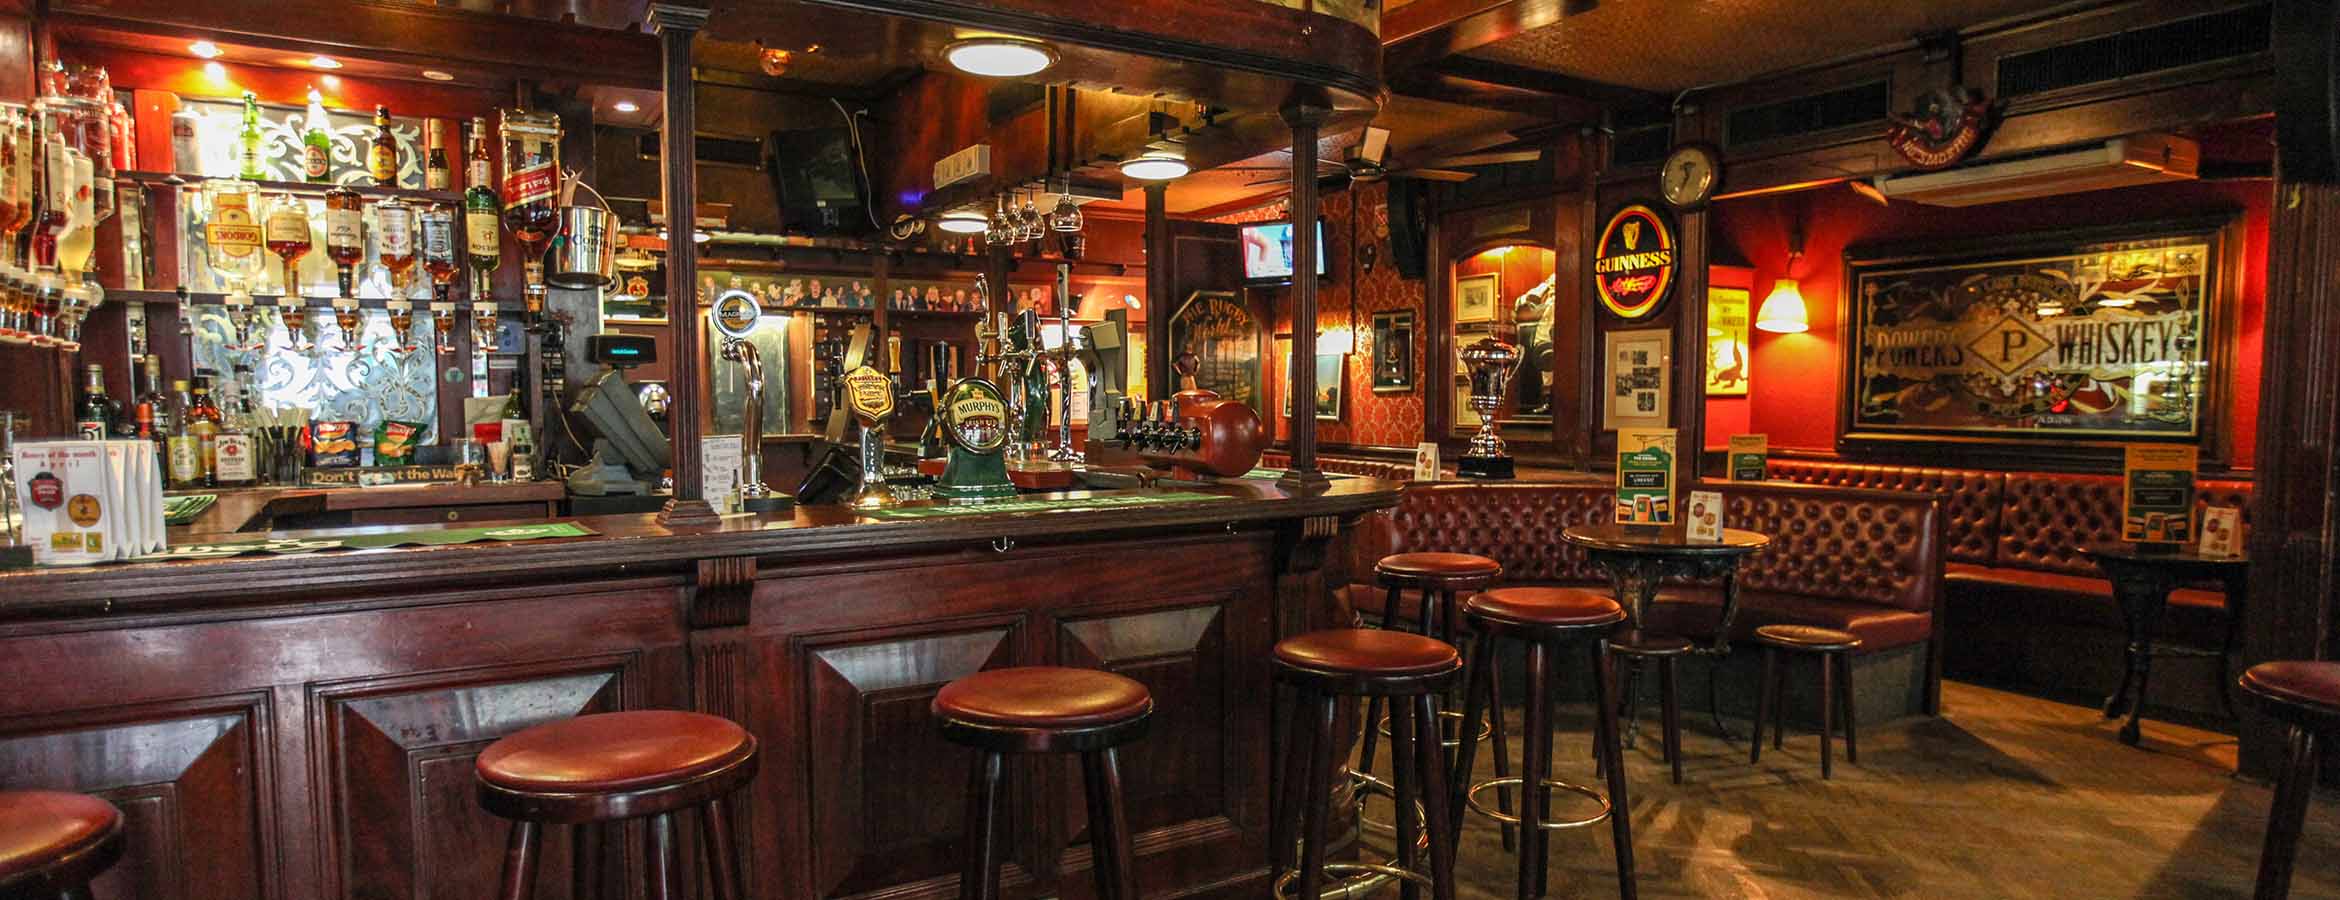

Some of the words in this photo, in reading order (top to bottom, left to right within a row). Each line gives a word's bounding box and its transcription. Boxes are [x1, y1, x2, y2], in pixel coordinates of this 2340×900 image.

[1595, 250, 1672, 274] GUINNESS
[1876, 327, 1965, 368] POWERS
[2001, 329, 2028, 362] P
[2056, 320, 2174, 366] WHISKEY
[958, 401, 1000, 415] MURPHY'S
[312, 470, 354, 482] Don't
[408, 467, 430, 479] the
